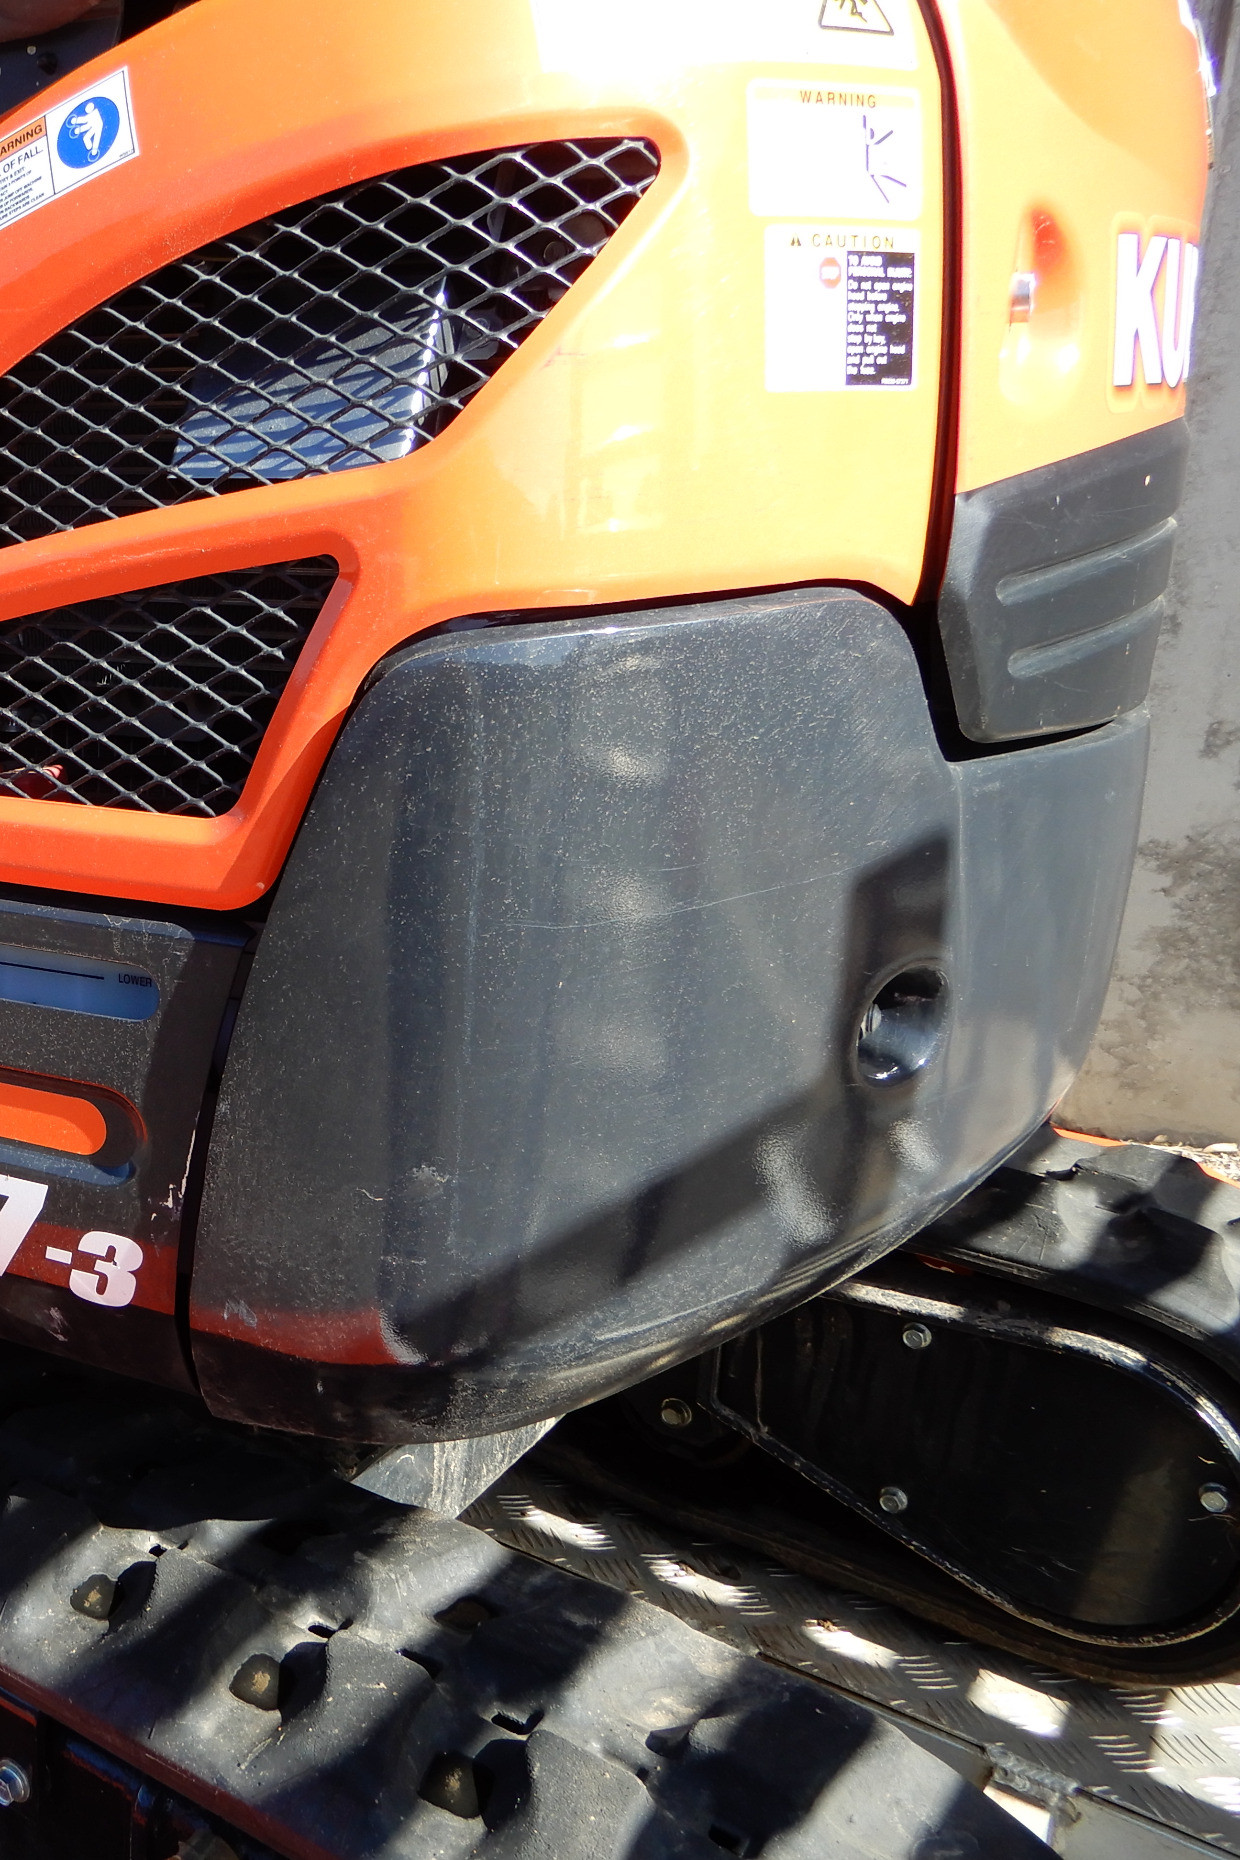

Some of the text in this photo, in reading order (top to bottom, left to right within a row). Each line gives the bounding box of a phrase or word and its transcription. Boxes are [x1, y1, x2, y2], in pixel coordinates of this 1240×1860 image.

[799, 90, 876, 109] WARNING
[3, 159, 16, 173] OF
[811, 233, 894, 250] CAUTION
[1113, 233, 1199, 388] KU
[118, 973, 152, 988] LOWER
